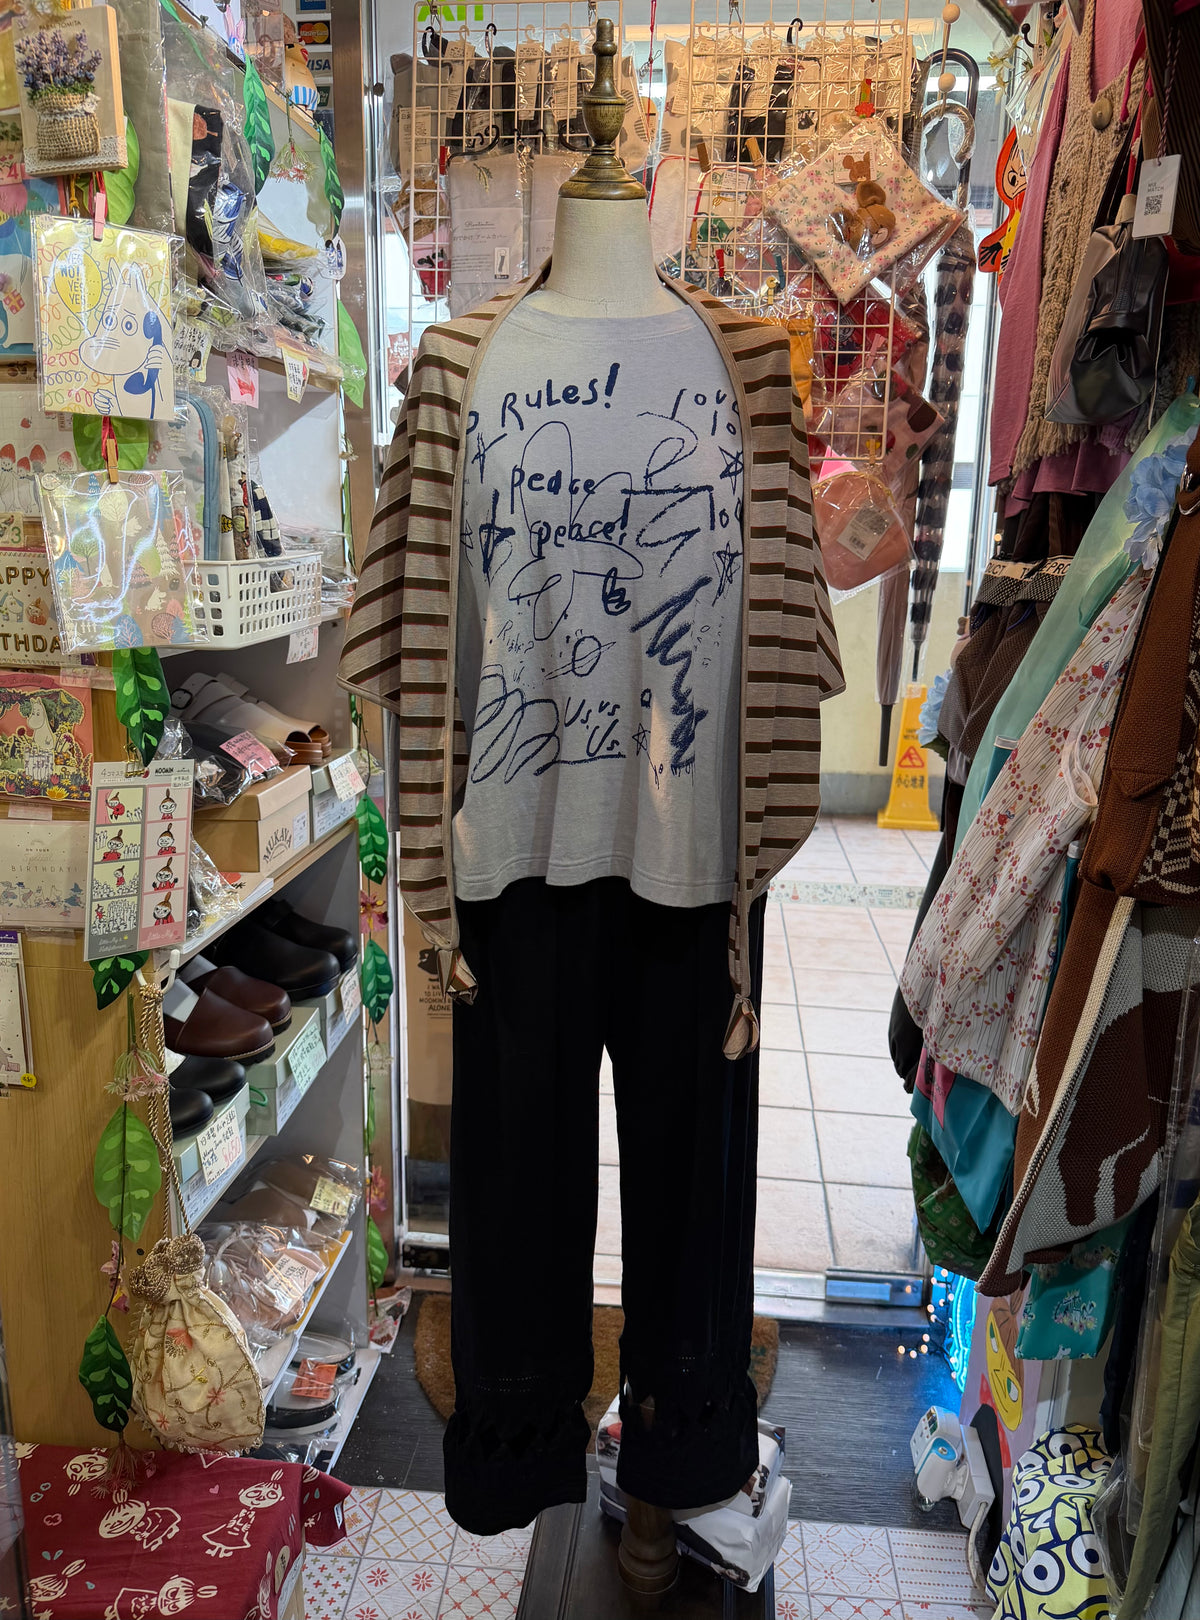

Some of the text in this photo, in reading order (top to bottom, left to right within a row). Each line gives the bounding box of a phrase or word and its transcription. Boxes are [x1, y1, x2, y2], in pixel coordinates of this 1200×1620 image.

[501, 362, 620, 431] Rules!
[511, 464, 596, 514] peace
[11, 527, 21, 544] 3
